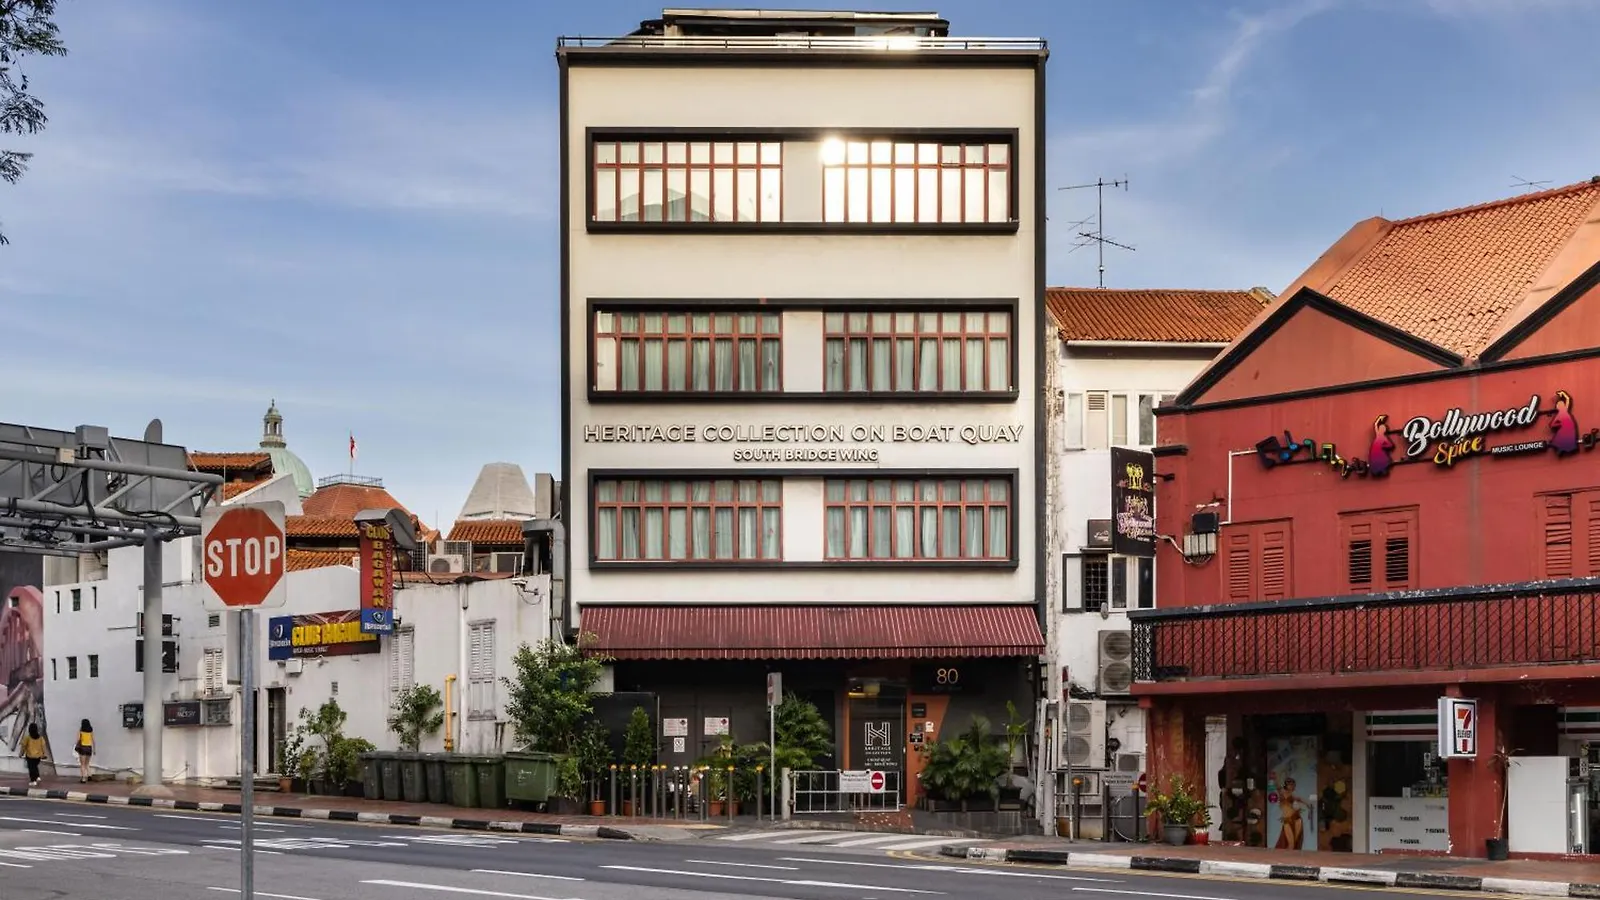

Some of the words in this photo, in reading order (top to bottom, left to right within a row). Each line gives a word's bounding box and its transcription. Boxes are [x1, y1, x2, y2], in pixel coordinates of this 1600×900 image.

[584, 424, 696, 442] HERITAGE
[703, 424, 844, 442] COLLECTION
[851, 424, 885, 442] ON
[892, 424, 954, 442] BOAT
[960, 424, 1024, 445] QUAY
[1403, 395, 1538, 457] Bollywood
[733, 448, 782, 462] SOUTH
[785, 448, 836, 462] BRIDGE
[840, 448, 879, 462] WING
[1433, 435, 1483, 466] Spice
[1491, 446, 1514, 454] MUSIC
[1514, 441, 1544, 452] LOUNGE
[366, 525, 390, 540] CLUB
[207, 535, 281, 578] STOP
[291, 625, 321, 647] CLUB
[937, 668, 959, 684] 80
